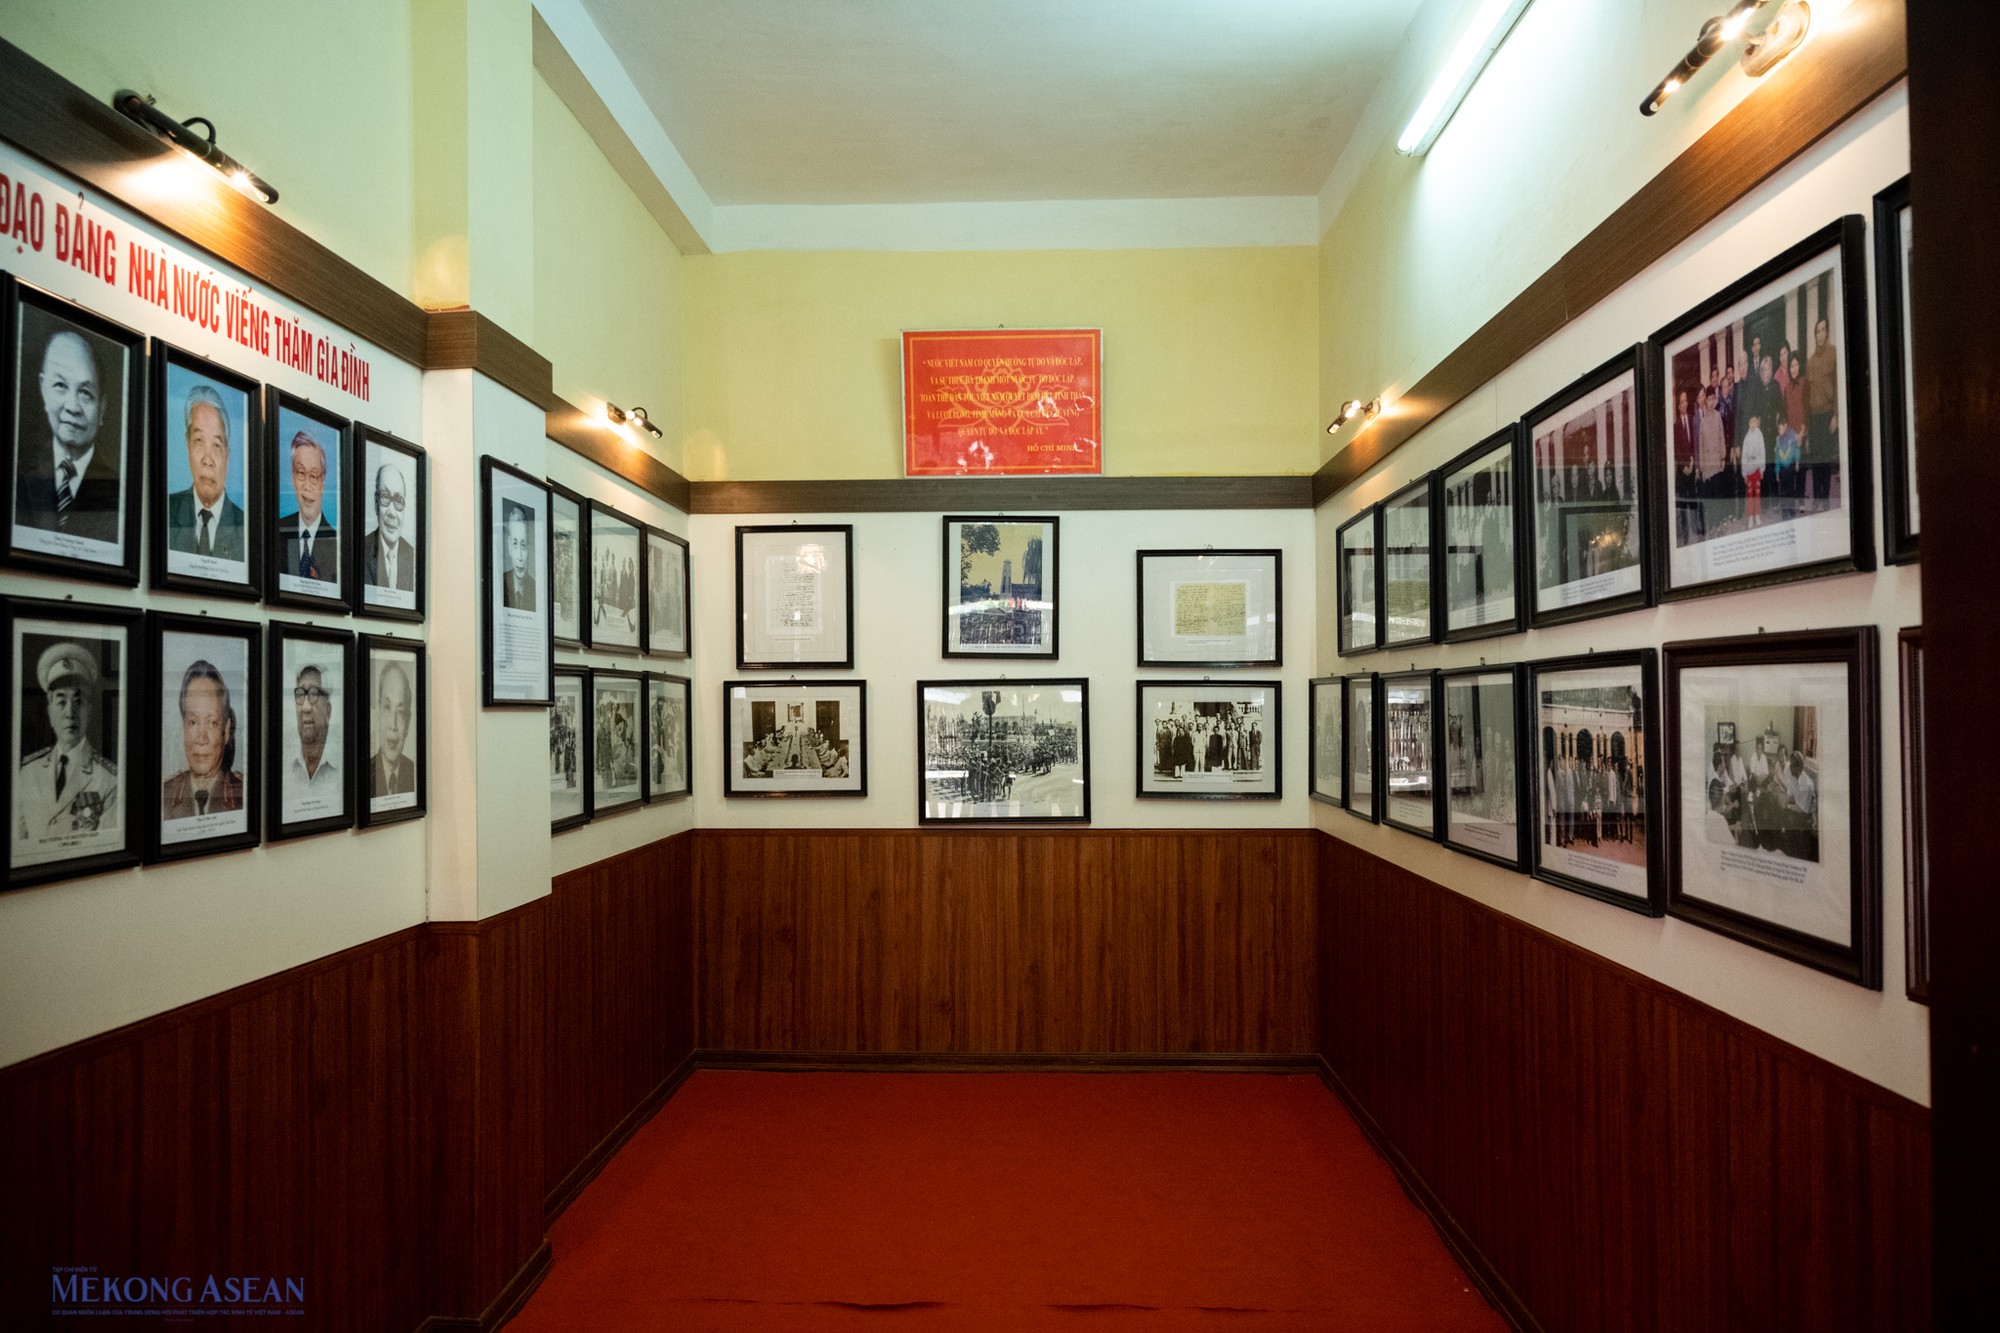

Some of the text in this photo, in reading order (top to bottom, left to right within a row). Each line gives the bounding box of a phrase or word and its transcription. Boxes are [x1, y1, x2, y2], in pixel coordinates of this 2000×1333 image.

[0, 173, 370, 402] ĐẠO ĐẢNG NHÀ NƯỚC VIẾNG THĂM GIA ĐÌNH
[1036, 356, 1046, 367] DO
[1027, 442, 1039, 452] HỒ
[1040, 442, 1054, 452] CHÍ
